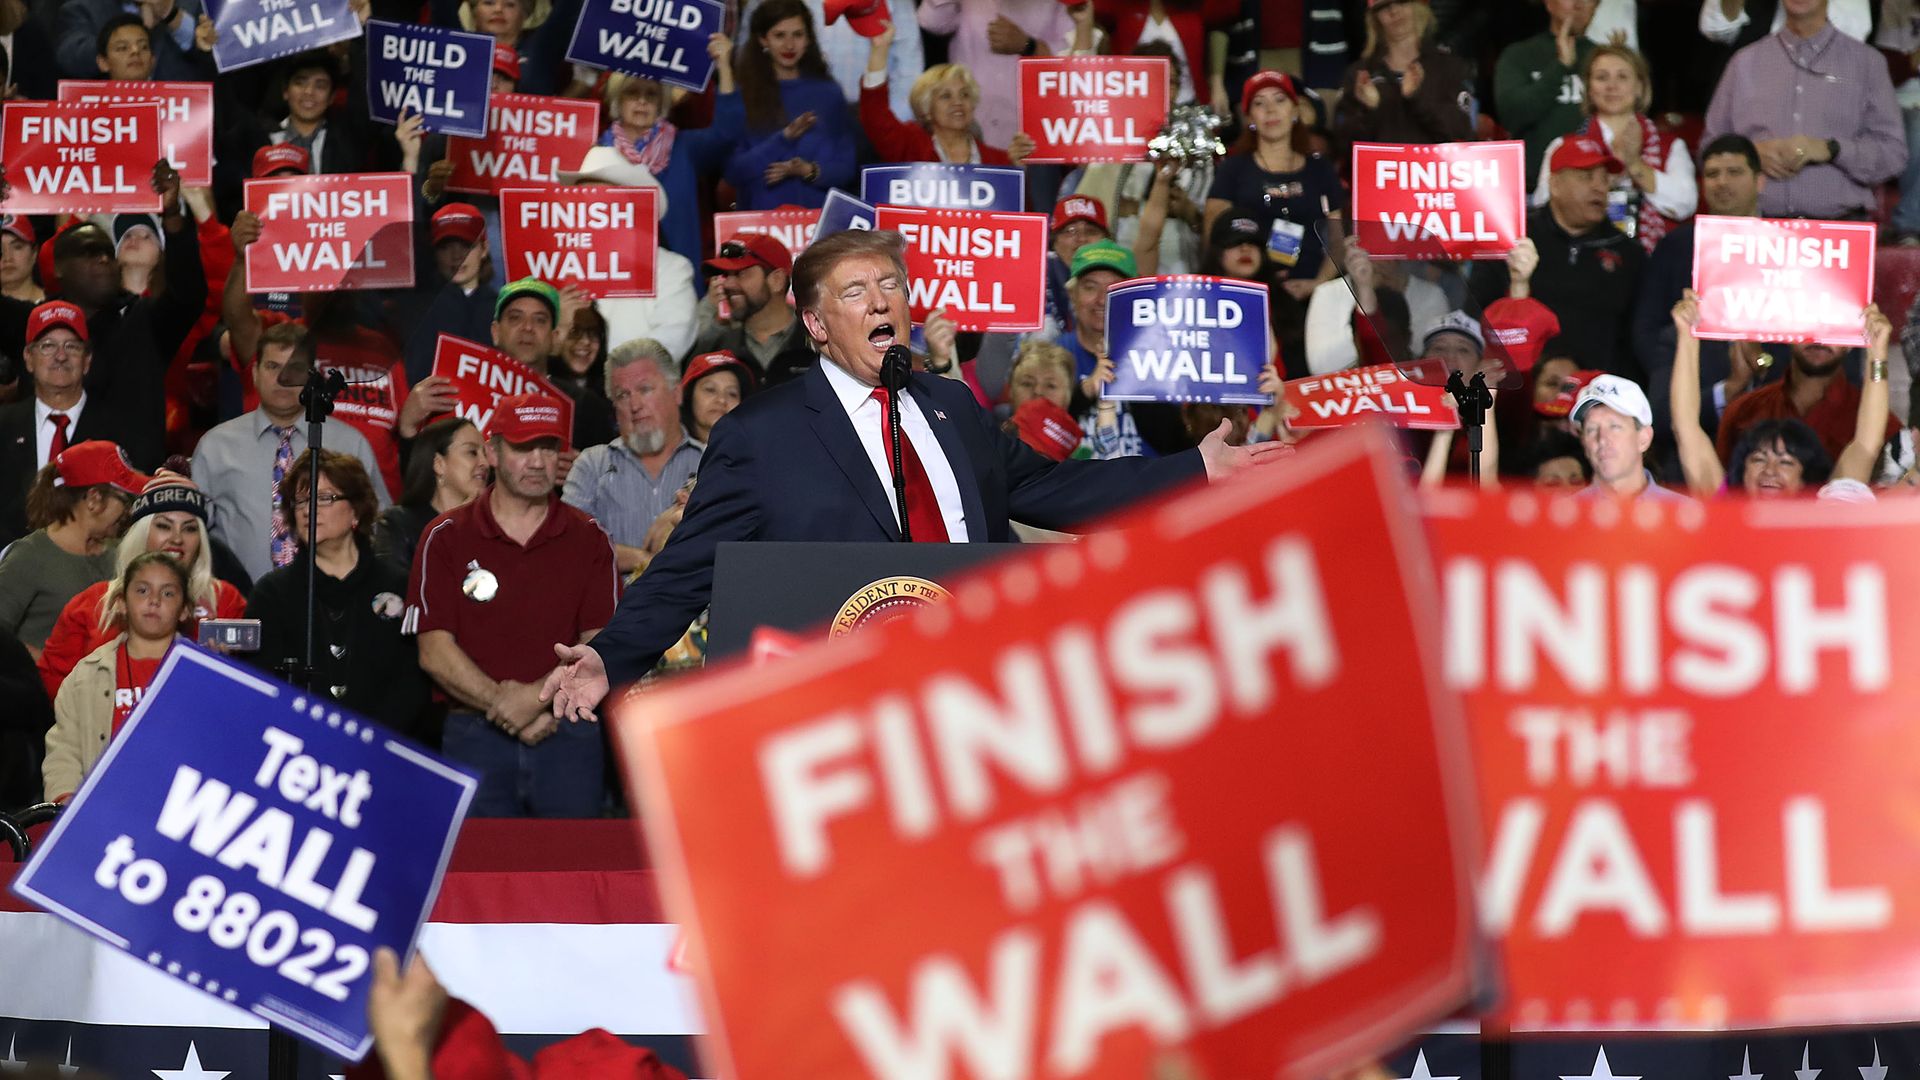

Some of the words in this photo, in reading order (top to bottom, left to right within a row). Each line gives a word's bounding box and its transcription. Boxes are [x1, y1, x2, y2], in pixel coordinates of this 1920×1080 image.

[261, 0, 297, 13] THE
[610, 0, 702, 31] BUILD
[233, 3, 336, 49] WALL
[634, 20, 670, 42] THE
[382, 34, 467, 69] BUILD
[598, 28, 690, 74] WALL
[403, 66, 436, 84] THE
[1038, 69, 1149, 97] FINISH
[380, 79, 466, 119] WALL
[1072, 99, 1110, 115] THE
[21, 116, 139, 145] FINISH
[489, 107, 578, 138] INISH
[1041, 116, 1146, 147] WALL
[57, 147, 97, 163] THE
[502, 135, 538, 153] THE
[24, 164, 138, 195] WALL
[1375, 158, 1500, 191] FINISH
[267, 189, 389, 222] FINISH
[889, 179, 996, 208] BUILD
[1413, 192, 1457, 211] THE
[306, 221, 347, 239] THE
[519, 201, 636, 230] FINISH
[1378, 211, 1499, 243] WALL
[272, 239, 388, 274] WALL
[553, 232, 593, 249] THE
[898, 223, 1022, 260] FINISH
[1720, 233, 1850, 271] FINISH
[523, 250, 632, 282] WALL
[933, 258, 975, 278] THE
[1760, 268, 1804, 288] THE
[909, 278, 1016, 313] WALL
[1722, 287, 1844, 326] WALL
[1131, 297, 1244, 330] BUILD
[1167, 330, 1210, 349] THE
[1128, 349, 1249, 384] WALL
[1297, 365, 1425, 397] FINISH
[1308, 390, 1432, 419] WALL
[1343, 383, 1384, 397] THE
[834, 582, 899, 640] RESIDENT
[903, 583, 918, 593] OF
[920, 586, 940, 602] THE
[1440, 555, 1892, 698] INISH
[757, 528, 1342, 879] FINISH
[1508, 704, 1696, 788] THE
[253, 725, 374, 829] Text
[155, 764, 380, 934] WALL
[974, 768, 1188, 914] THE
[94, 834, 169, 905] to
[172, 875, 371, 1002] 88022
[830, 820, 1386, 1080] WALL
